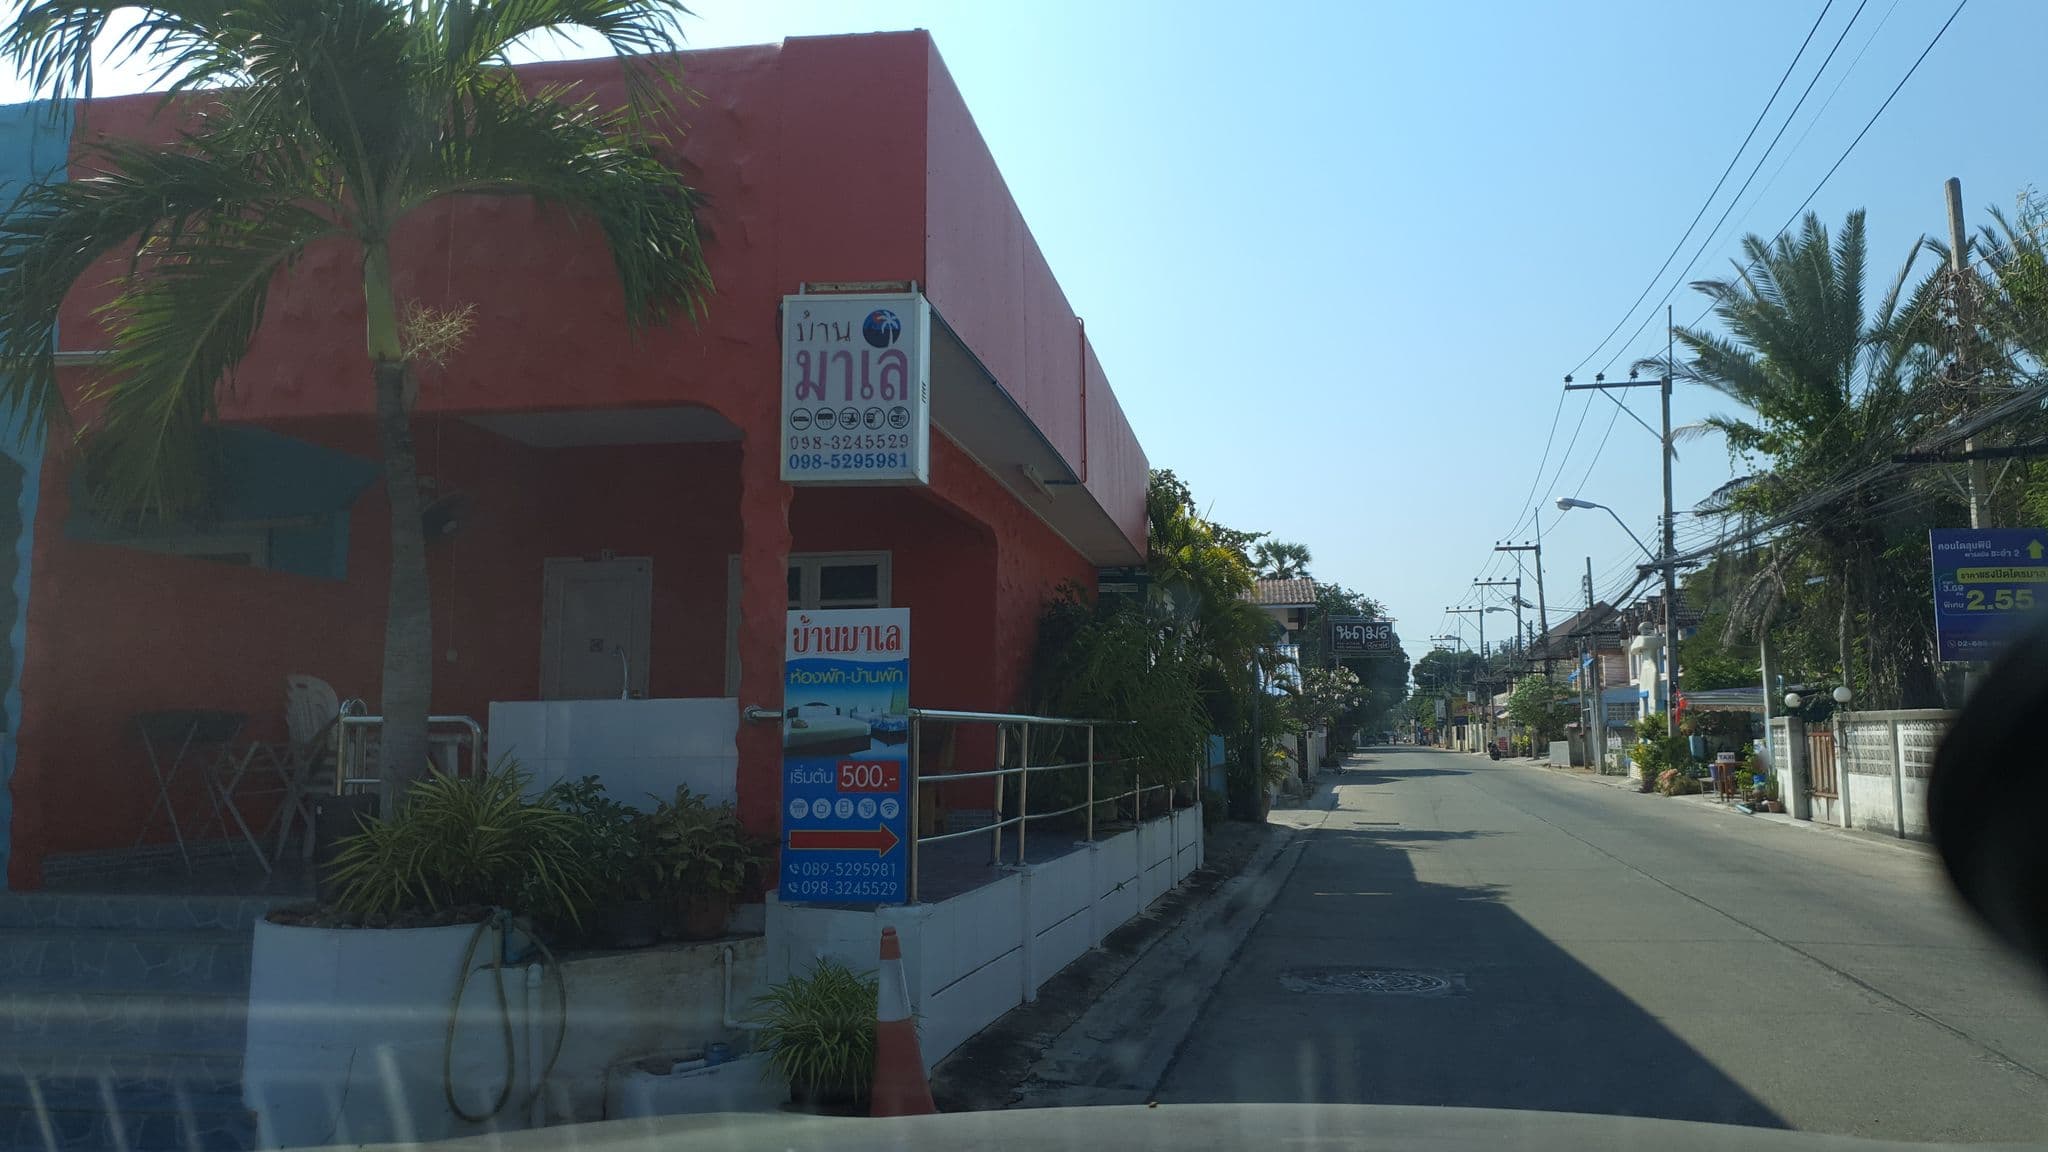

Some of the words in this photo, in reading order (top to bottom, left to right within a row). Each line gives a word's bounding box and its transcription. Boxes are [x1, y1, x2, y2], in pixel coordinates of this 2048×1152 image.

[796, 309, 851, 343] บ้าน
[795, 348, 909, 402] มาเล
[790, 434, 909, 450] 098-3245529
[789, 453, 909, 470] 098-5295981
[2014, 549, 2021, 558] 2
[1966, 588, 2035, 611] 2.55
[792, 614, 902, 654] บ้านมาเล
[790, 764, 834, 785] เริ่มต้น
[802, 861, 896, 878] 089-5295981
[801, 880, 898, 896] 098-3245529
